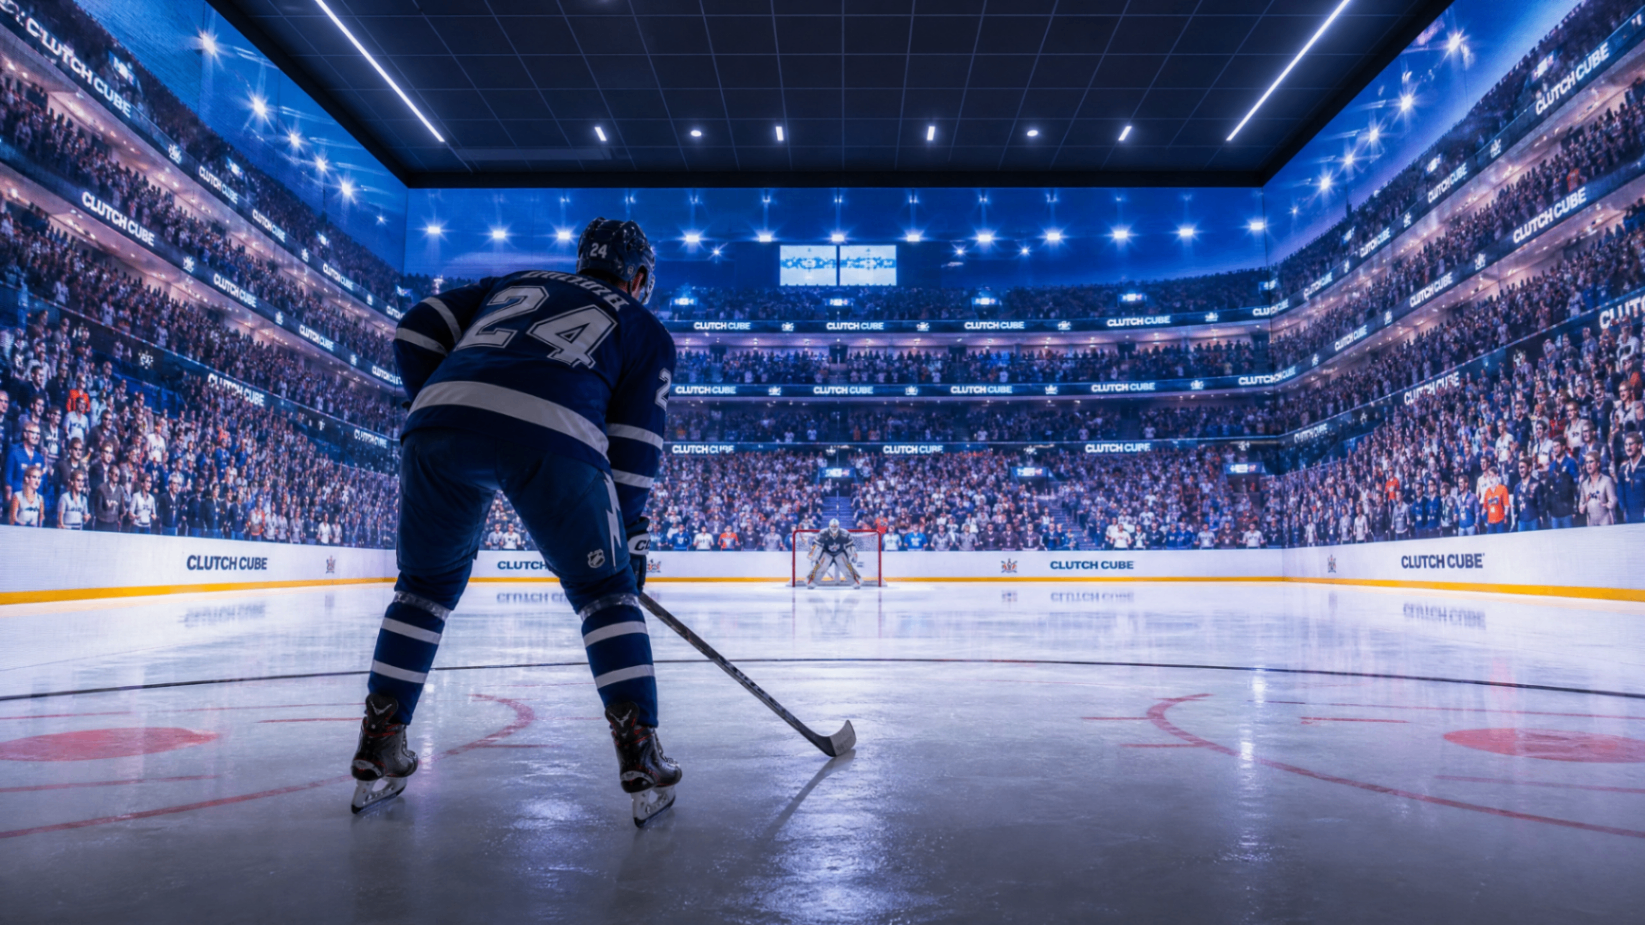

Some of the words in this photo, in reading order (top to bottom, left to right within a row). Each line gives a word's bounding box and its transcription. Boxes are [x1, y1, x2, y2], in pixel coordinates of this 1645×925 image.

[27, 17, 92, 85] CLUTCH
[93, 77, 131, 118] CUBE
[1535, 71, 1576, 115] CLUTCH
[1575, 42, 1610, 80] CUBE
[199, 165, 222, 191] CLUTCH
[221, 182, 238, 204] CUBE
[1428, 177, 1449, 203] CLUTCH
[1449, 163, 1468, 185] CUBE
[82, 191, 127, 232] CLUTCH
[127, 219, 155, 247] CUBE
[1513, 208, 1554, 243] CLUTCH
[1553, 187, 1587, 219] CUBE
[590, 242, 607, 259] 24
[213, 273, 239, 298] CLUTCH
[239, 288, 257, 308] CUBE
[1409, 285, 1435, 308] CLUTCH
[1435, 272, 1453, 293] CUBE
[454, 286, 617, 369] 24
[694, 322, 727, 330] CLUTCH
[727, 322, 751, 330] CUBE
[826, 322, 860, 330] CLUTCH
[860, 322, 884, 330] CUBE
[964, 321, 999, 330] CLUTCH
[999, 321, 1025, 329] CUBE
[1107, 317, 1144, 327] CLUTCH
[1144, 315, 1171, 325] CUBE
[300, 325, 320, 345] CLUTCH
[1335, 334, 1354, 351] CLUTCH
[675, 386, 711, 394] CLUTCH
[711, 386, 736, 394] CUBE
[813, 386, 848, 394] CLUTCH
[849, 386, 873, 394] CUBE
[950, 385, 987, 394] CLUTCH
[987, 385, 1012, 394] CUBE
[1091, 383, 1128, 393] CLUTCH
[1129, 382, 1155, 391] CUBE
[244, 388, 264, 407] CUBE
[672, 445, 709, 454] CLUTCH
[883, 445, 918, 454] CLUTCH
[1085, 444, 1123, 453] CLUTCH
[186, 554, 237, 571] CLUTCH
[238, 556, 268, 570] CUBE
[497, 560, 548, 570] CLUTCH
[1050, 560, 1099, 570] CLUTCH
[1100, 560, 1134, 570] CUBE
[1401, 554, 1445, 569] CLUTCH
[1447, 553, 1484, 569] CUBE
